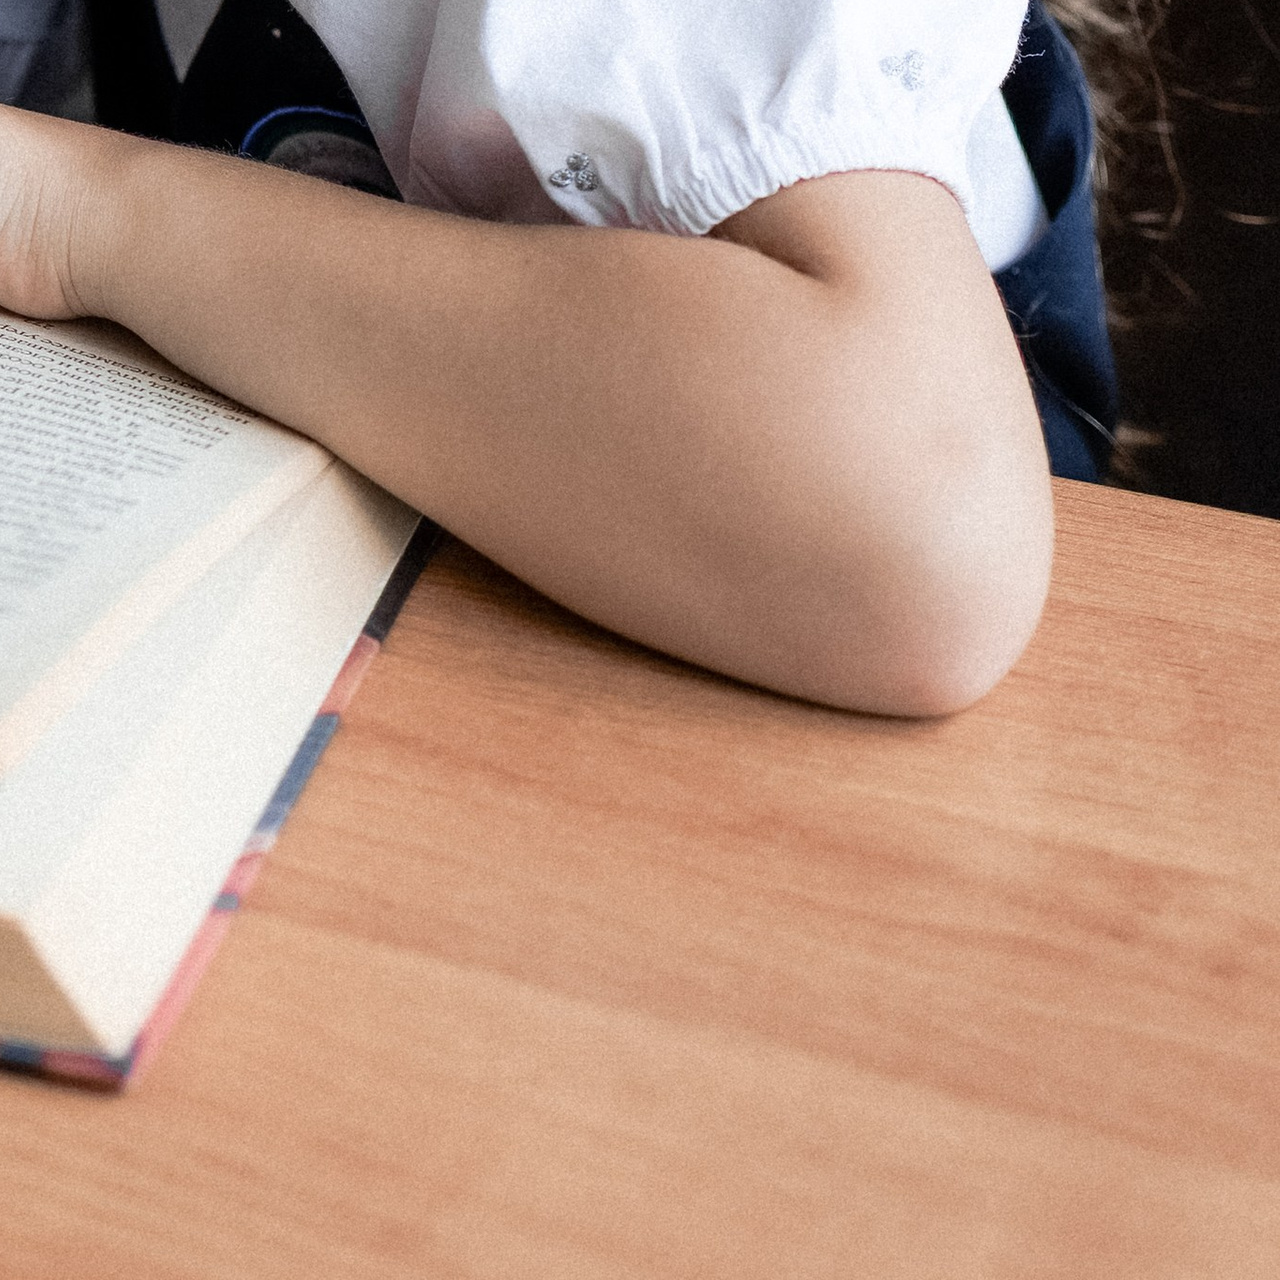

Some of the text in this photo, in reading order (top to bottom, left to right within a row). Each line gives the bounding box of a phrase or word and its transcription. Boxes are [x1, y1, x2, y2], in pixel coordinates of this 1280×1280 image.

[40, 338, 156, 378] незаметнее
[75, 367, 102, 378] но
[107, 369, 141, 384] что
[45, 378, 100, 394] маме
[50, 368, 144, 400] внезапно
[106, 376, 145, 393] пот,
[148, 380, 188, 397] вид,
[148, 391, 220, 416] только
[149, 399, 208, 421] Гарри
[222, 414, 250, 425] не
